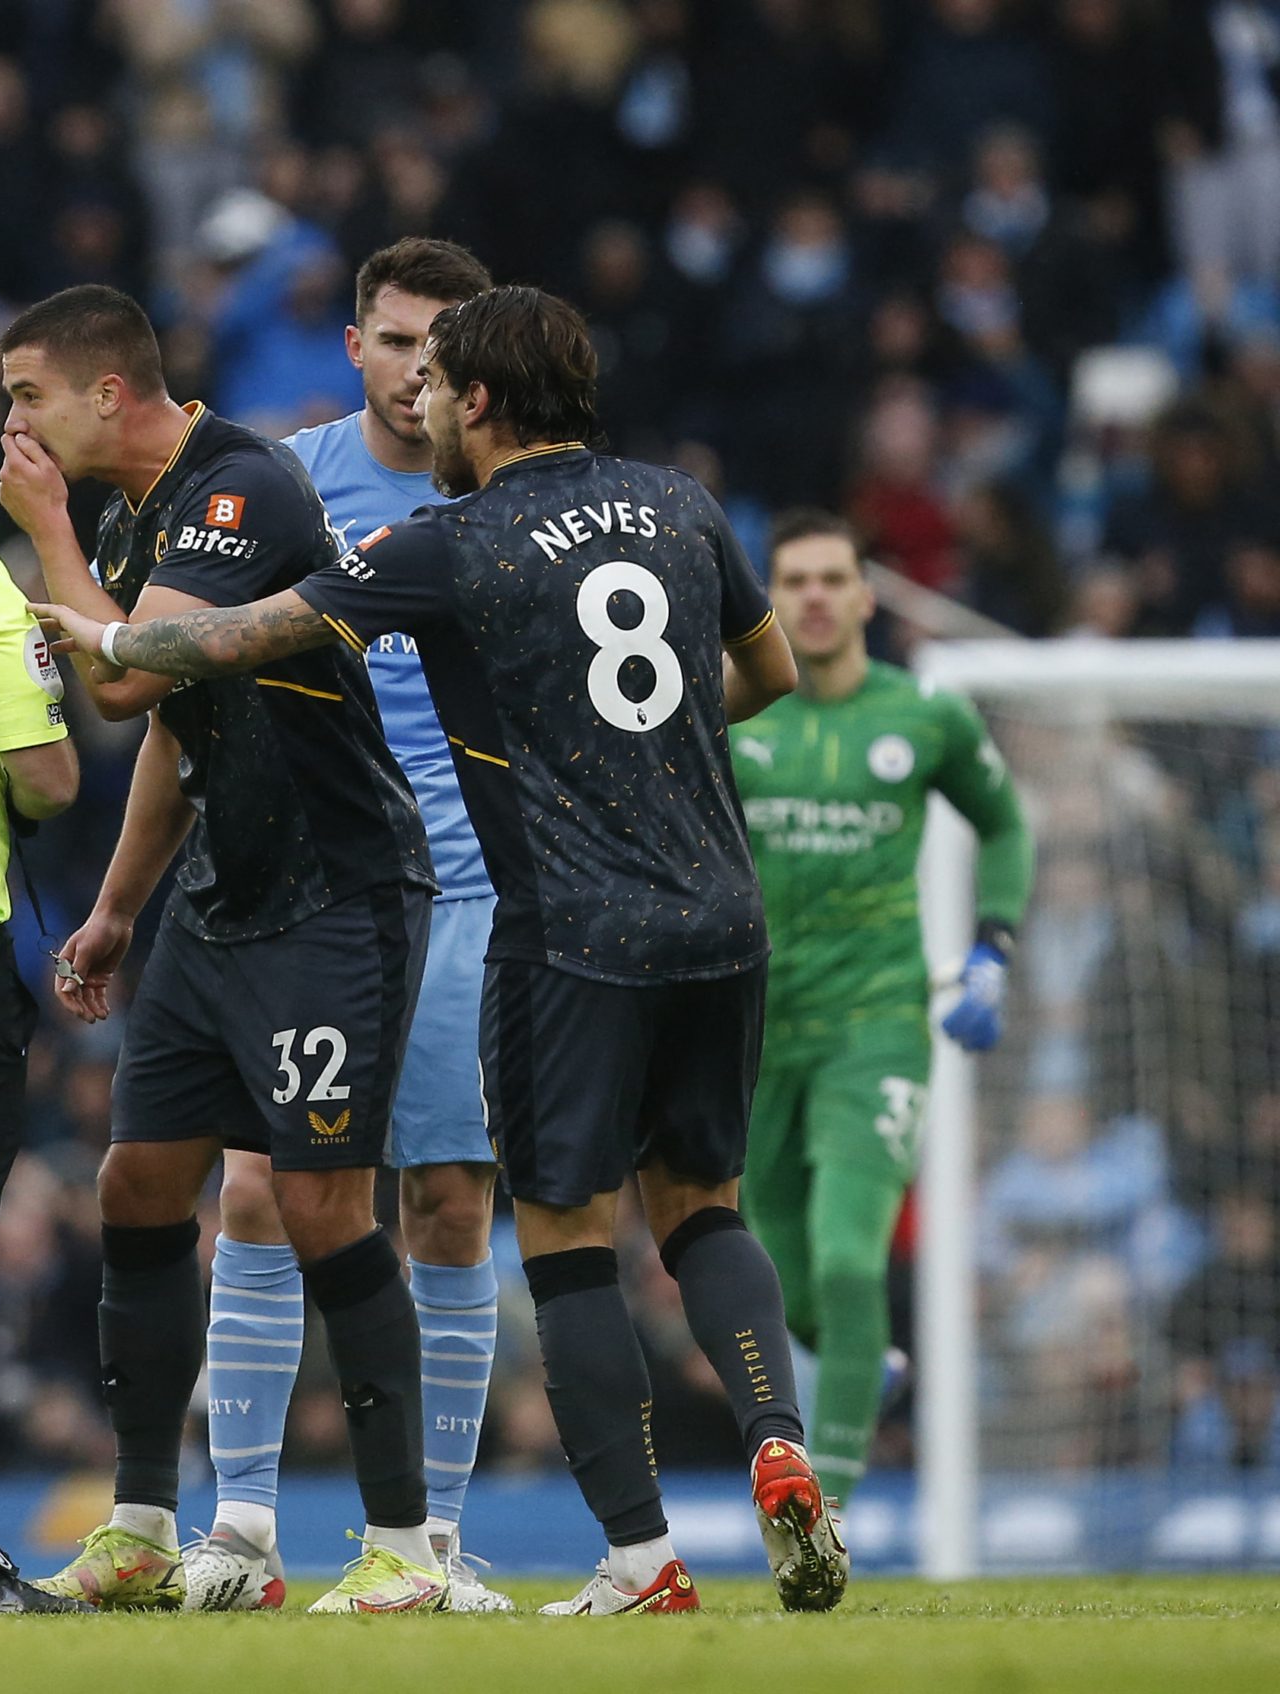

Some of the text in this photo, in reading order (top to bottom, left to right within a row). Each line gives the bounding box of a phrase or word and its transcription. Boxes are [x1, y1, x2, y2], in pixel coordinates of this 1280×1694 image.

[176, 525, 248, 558] Bitci
[529, 500, 658, 562] NEVES
[576, 560, 684, 733] 8
[271, 1025, 351, 1105] 32
[310, 1135, 351, 1145] CASTORE
[734, 1328, 774, 1403] CASTORE
